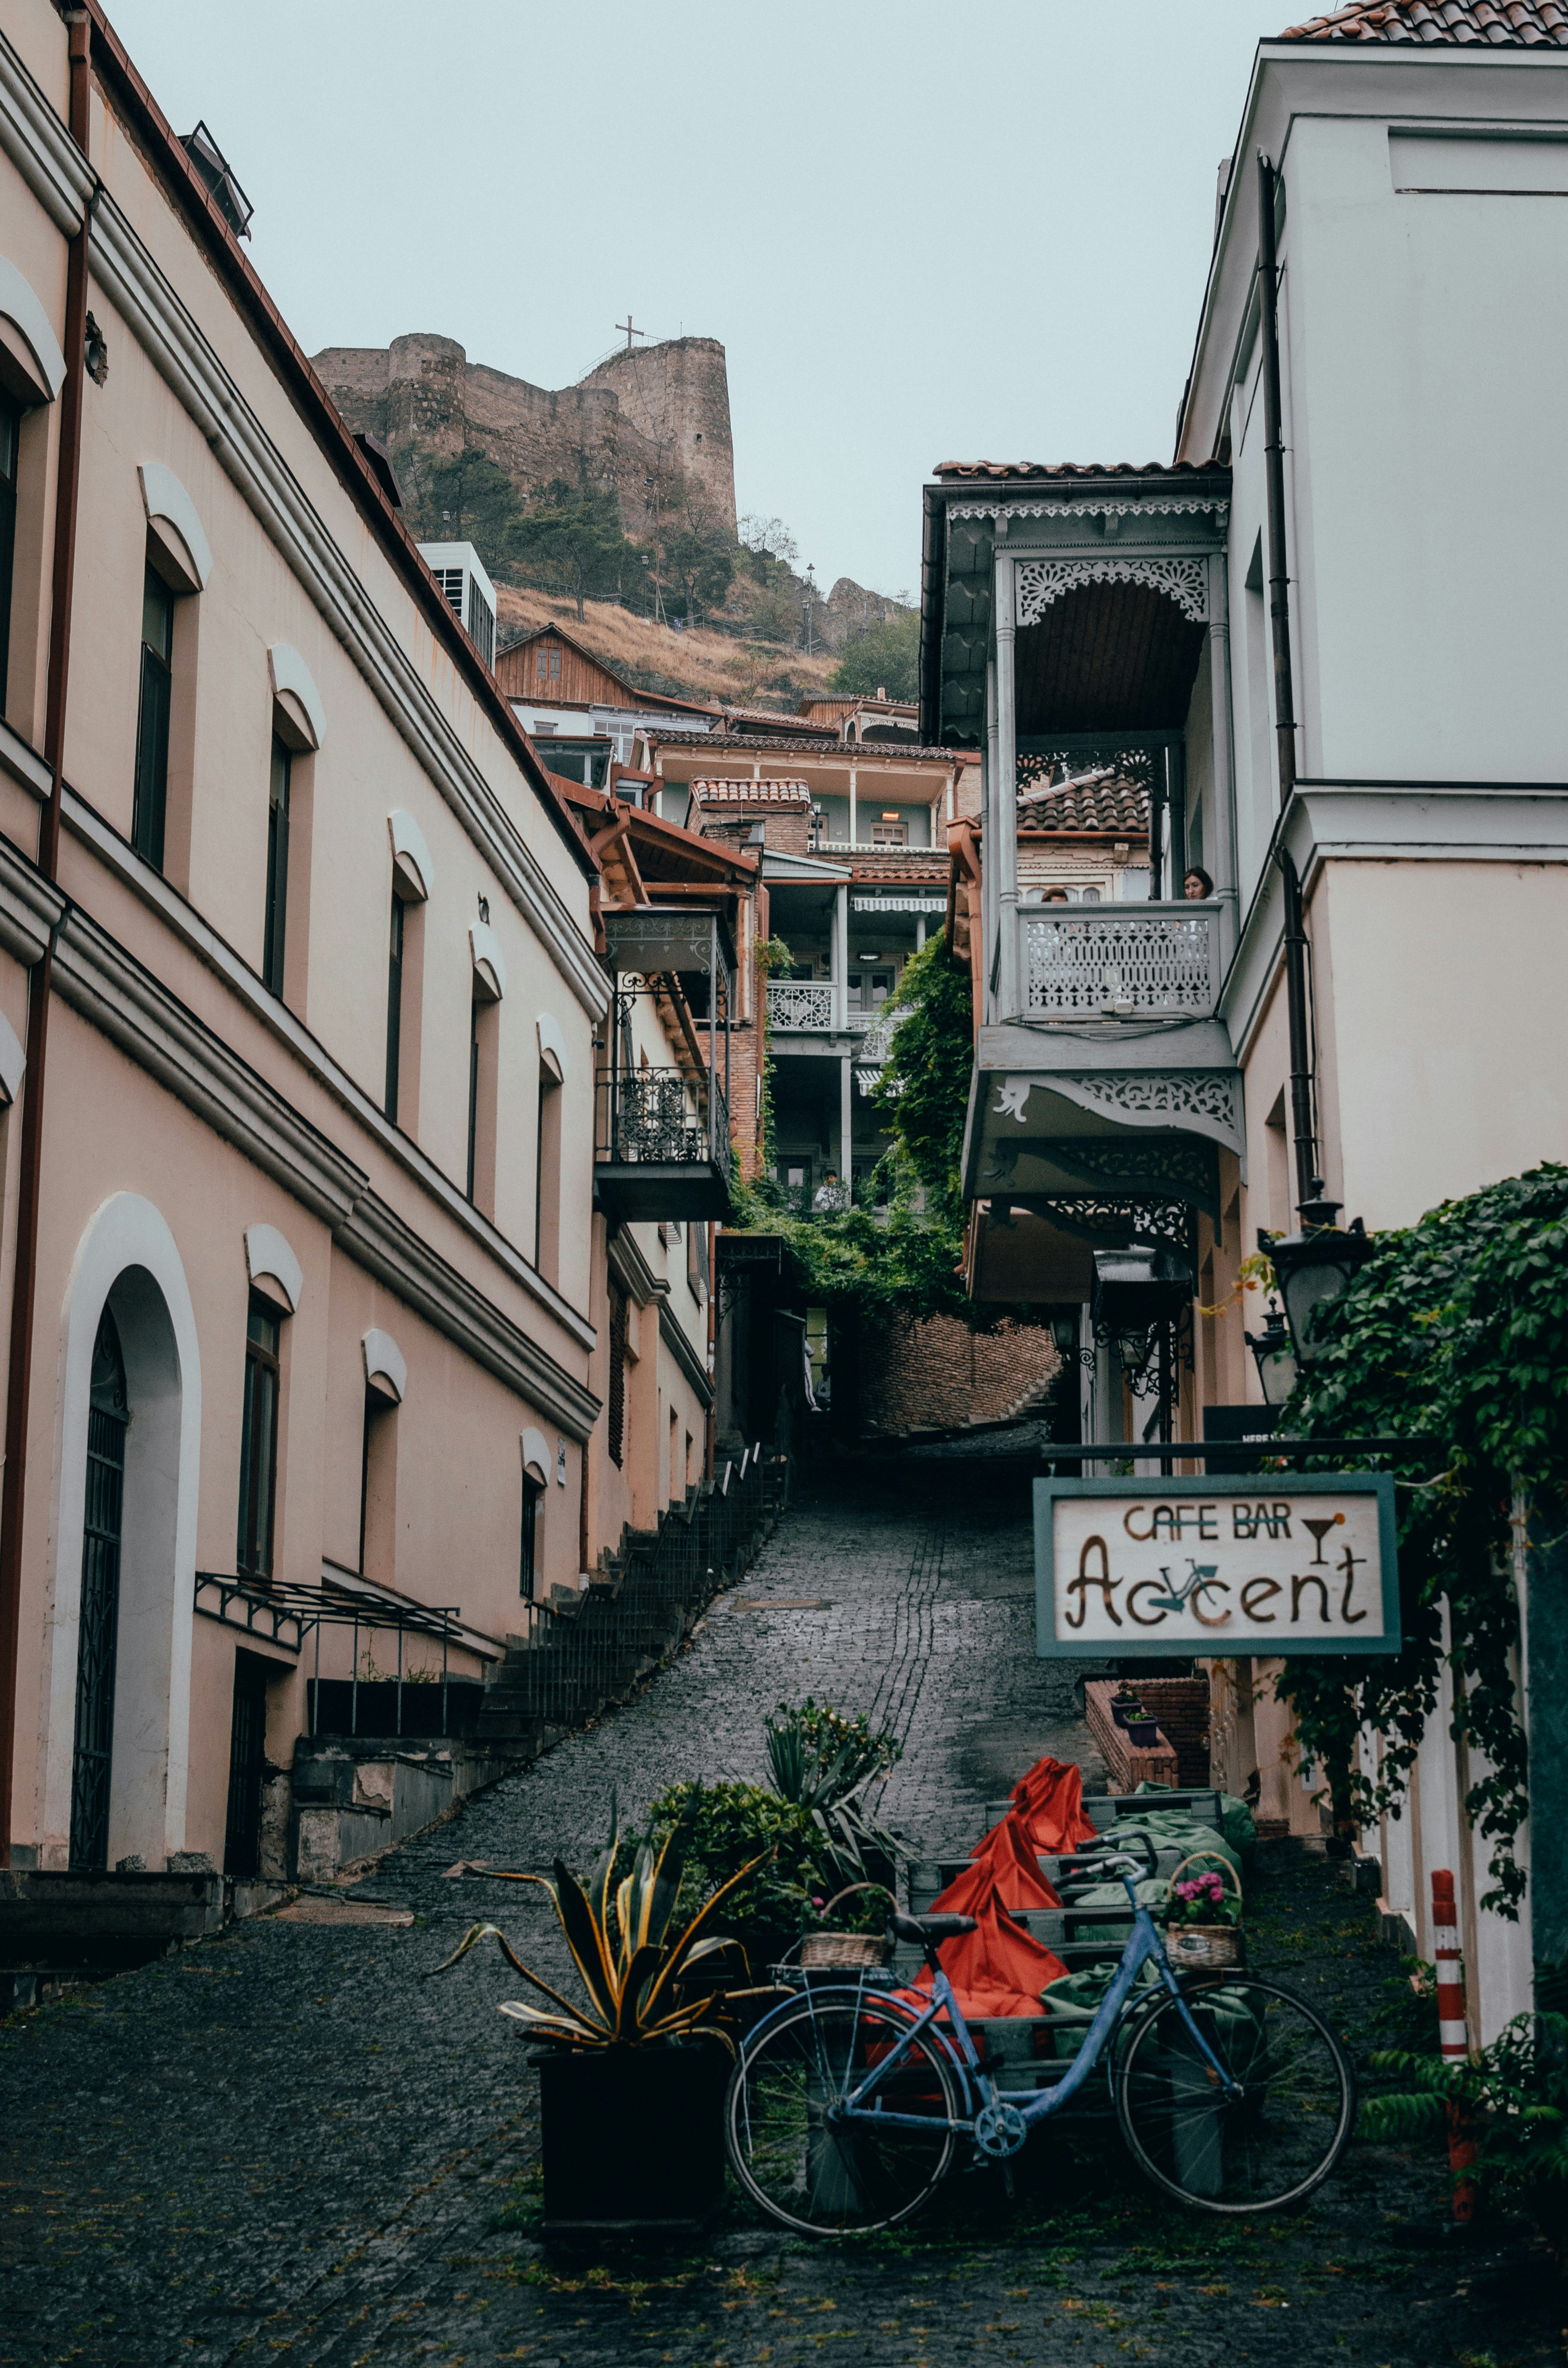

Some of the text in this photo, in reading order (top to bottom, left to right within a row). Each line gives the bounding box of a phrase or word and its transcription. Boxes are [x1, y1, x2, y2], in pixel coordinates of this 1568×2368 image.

[1124, 1502, 1291, 1541] CAFE BAR
[1064, 1535, 1368, 1629] Accent
